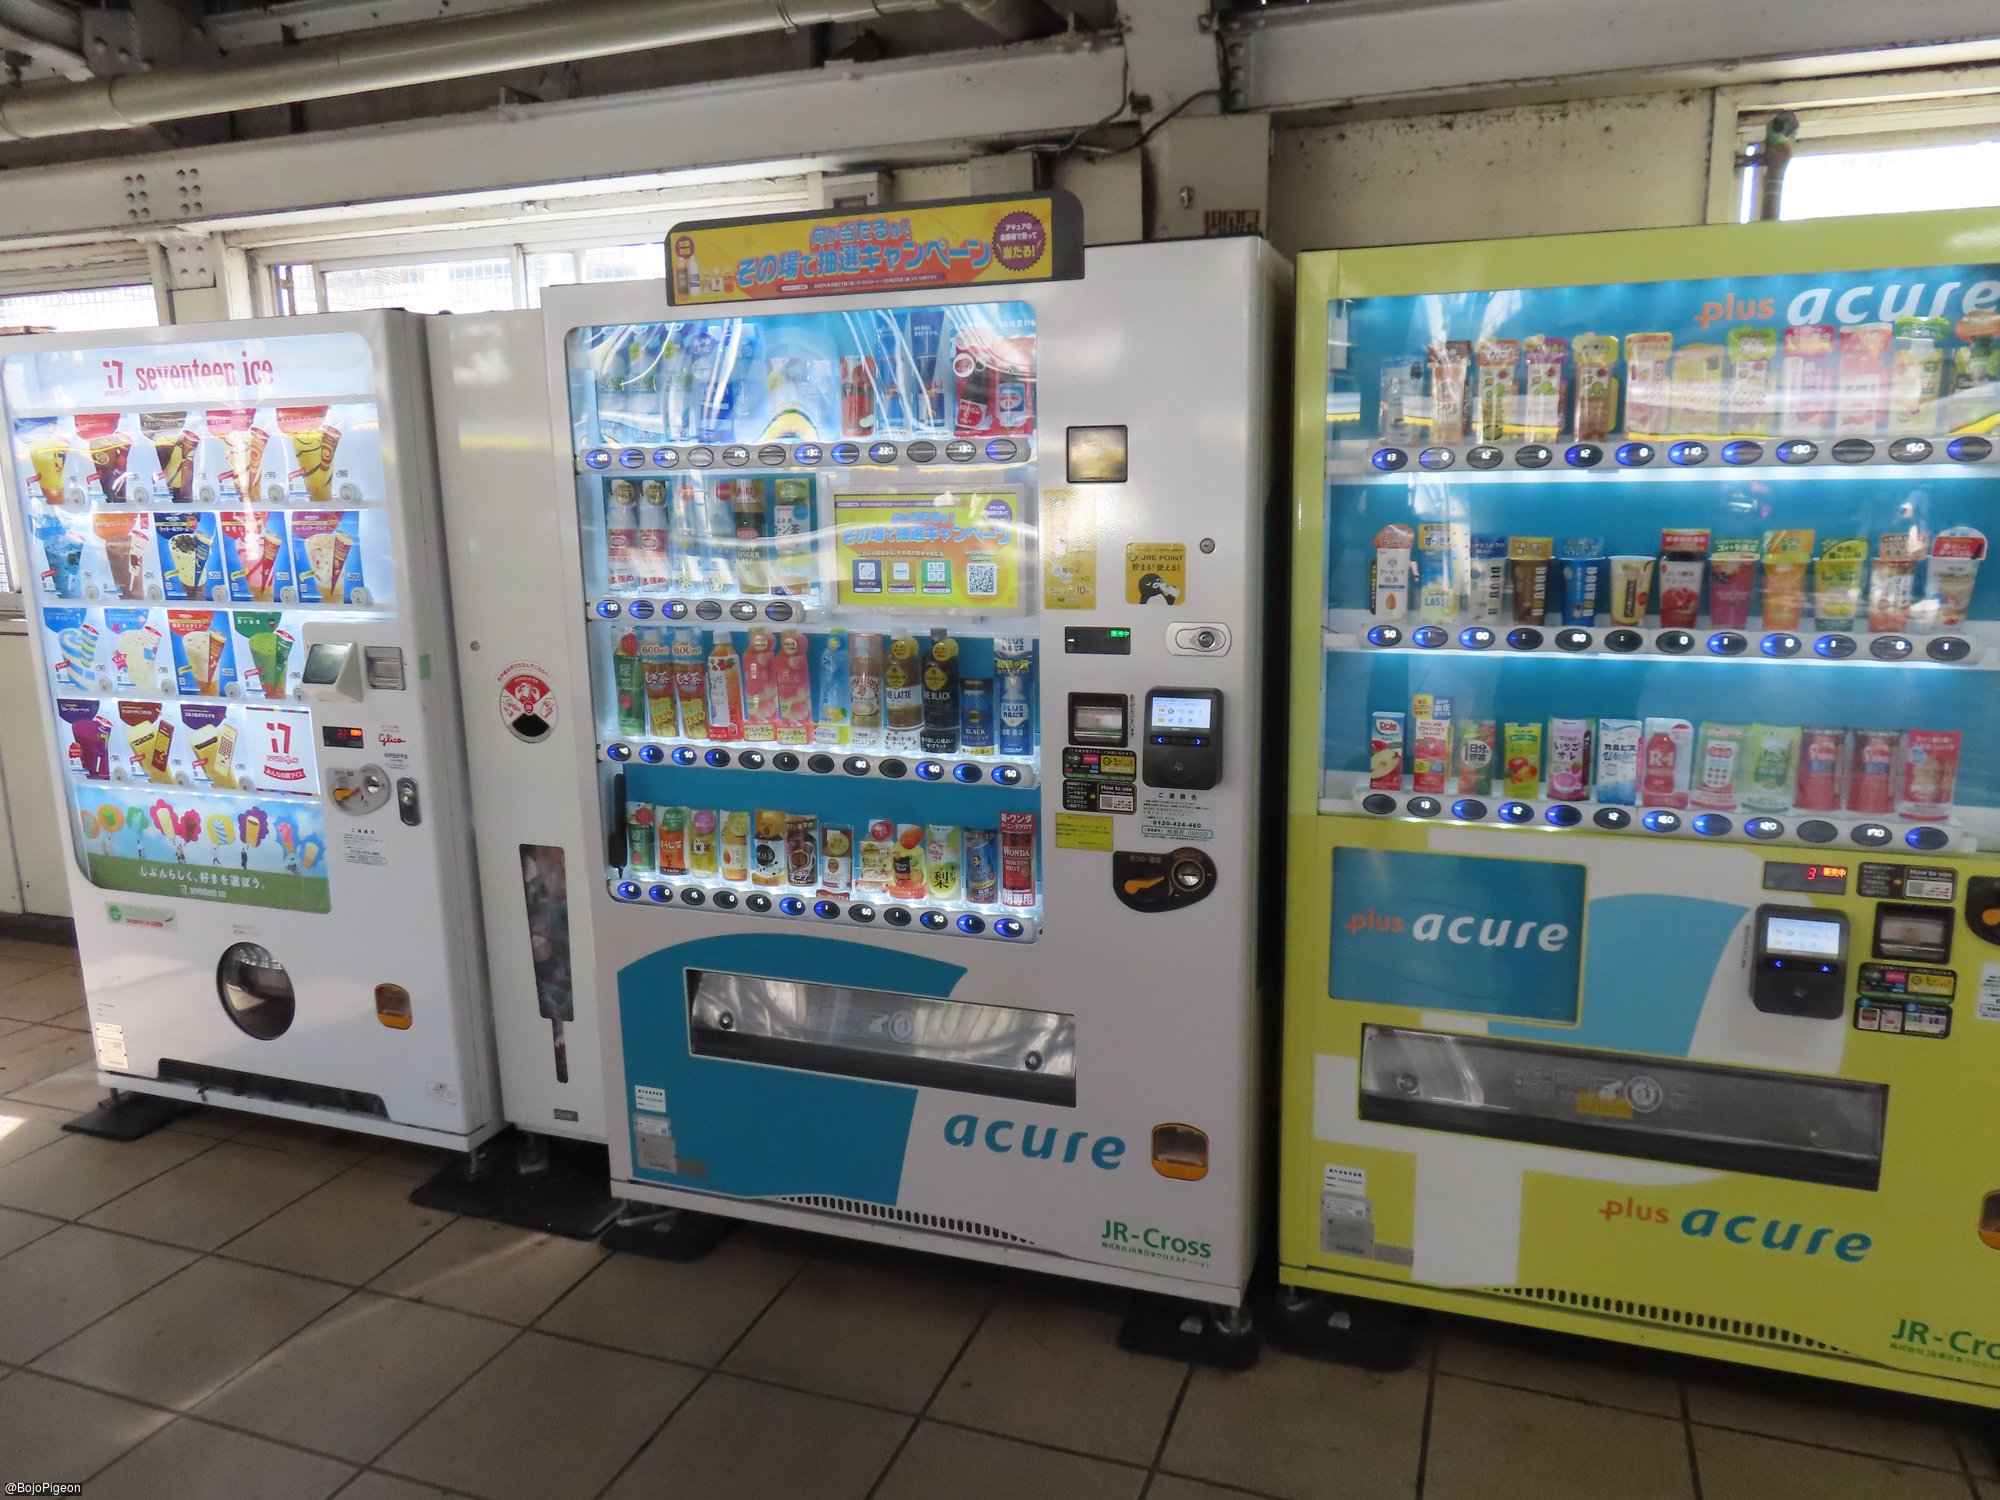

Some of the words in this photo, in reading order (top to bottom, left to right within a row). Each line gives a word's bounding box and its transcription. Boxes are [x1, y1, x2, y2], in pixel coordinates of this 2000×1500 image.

[736, 238, 992, 287] その場で抽選キャンペーン
[1786, 279, 2000, 326] acure
[135, 358, 238, 391] seventeen
[242, 350, 274, 386] ice
[931, 691, 951, 700] BLACK
[1003, 704, 1024, 712] PLUS
[1380, 722, 1397, 731] Dole
[379, 733, 406, 747] Glico
[1604, 744, 1636, 752] カルピス
[1152, 820, 1202, 829] 0120-424-480
[1003, 846, 1030, 857] WONDA
[933, 870, 949, 889] 梨
[1346, 909, 1405, 936] plus
[1413, 912, 1569, 953] acure
[944, 1114, 1126, 1170] acure
[1101, 1219, 1212, 1259] JR-Cross
[1599, 1197, 1670, 1223] plus
[1680, 1207, 1873, 1263] acure
